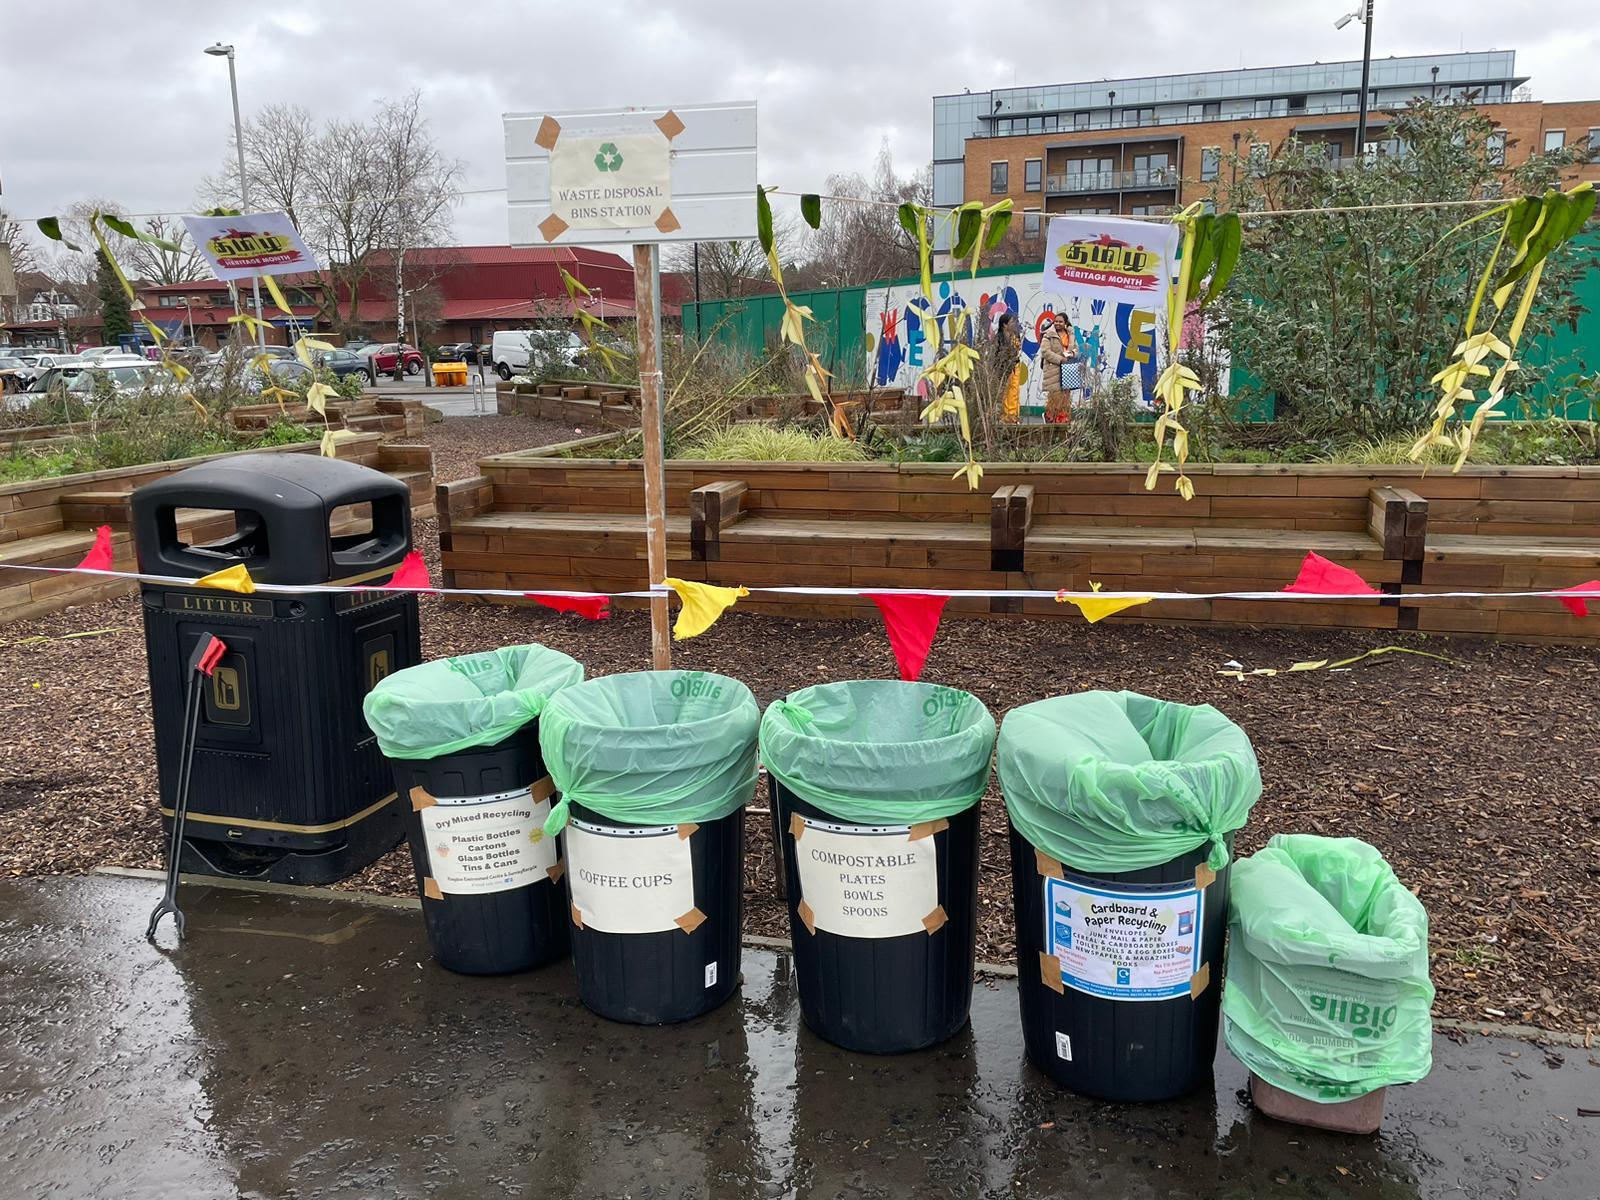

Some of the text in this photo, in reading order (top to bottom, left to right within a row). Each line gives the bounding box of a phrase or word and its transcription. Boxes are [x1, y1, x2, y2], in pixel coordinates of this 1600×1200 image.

[559, 186, 663, 201] WASTE DISPOSAL
[571, 205, 652, 219] BINS STATION
[224, 255, 291, 267] HERITAGE MONTH
[1065, 241, 1148, 272] தமிழ்
[1063, 269, 1143, 287] HERITAGE MONTH
[183, 596, 254, 614] LITTER
[435, 809, 531, 830] Dry Mixed Recycling
[452, 828, 521, 844] Plastic Bottles
[468, 841, 507, 853] Cartons
[457, 848, 520, 863] Glass Bottles
[811, 849, 916, 867] COMPOSTABLE
[462, 858, 518, 872] Tins & Cans
[579, 868, 673, 888] COFFEE CUPS
[839, 873, 886, 885] PLATES
[843, 890, 884, 901] BOWLS
[842, 906, 888, 917] SPOONS
[1091, 903, 1158, 918] Cardboard &
[1084, 915, 1167, 935] Paper Recycling
[1105, 928, 1147, 936] ENVELOPES
[1073, 932, 1098, 944] CEREAL
[1108, 941, 1154, 949] CARDBOARD
[1156, 940, 1178, 948] BOXES
[1089, 931, 1107, 939] JUNK
[1075, 945, 1123, 960] NEWSPAPERS
[1133, 953, 1175, 961] MAGAZINES
[1076, 939, 1099, 950] TOILET
[1101, 946, 1125, 954] ROLLS
[1152, 947, 1175, 955] BOXES
